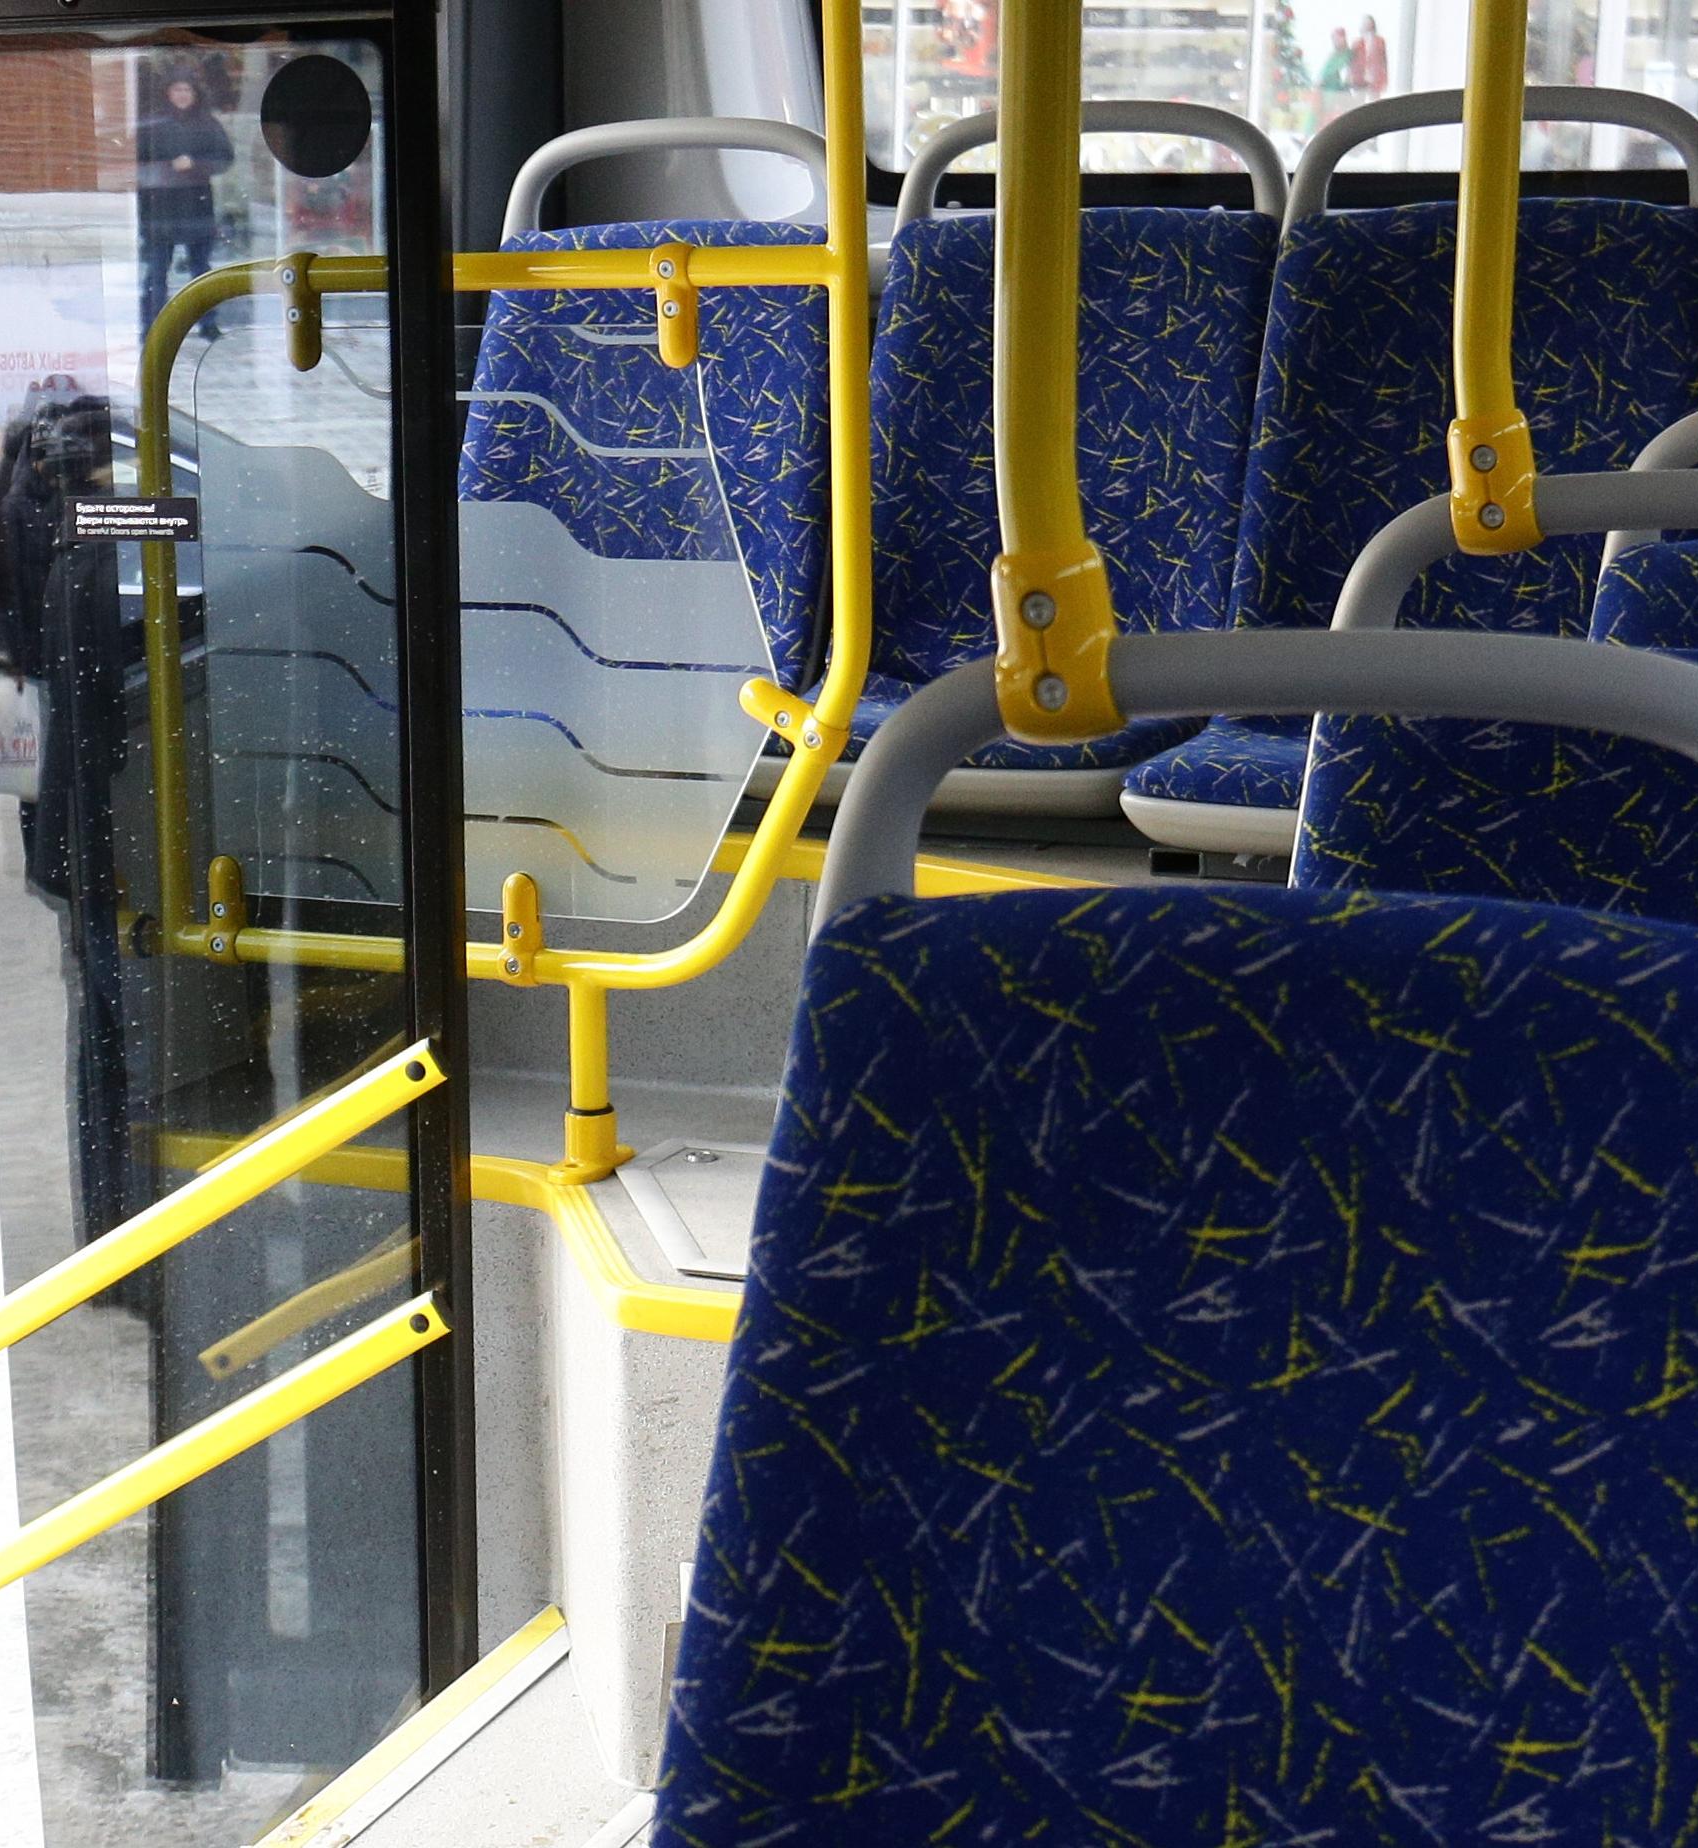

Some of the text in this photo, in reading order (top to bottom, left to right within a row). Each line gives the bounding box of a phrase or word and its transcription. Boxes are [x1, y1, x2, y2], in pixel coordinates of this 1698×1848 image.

[76, 502, 104, 514] Будьте
[76, 515, 189, 527] Двери открываются внутрь
